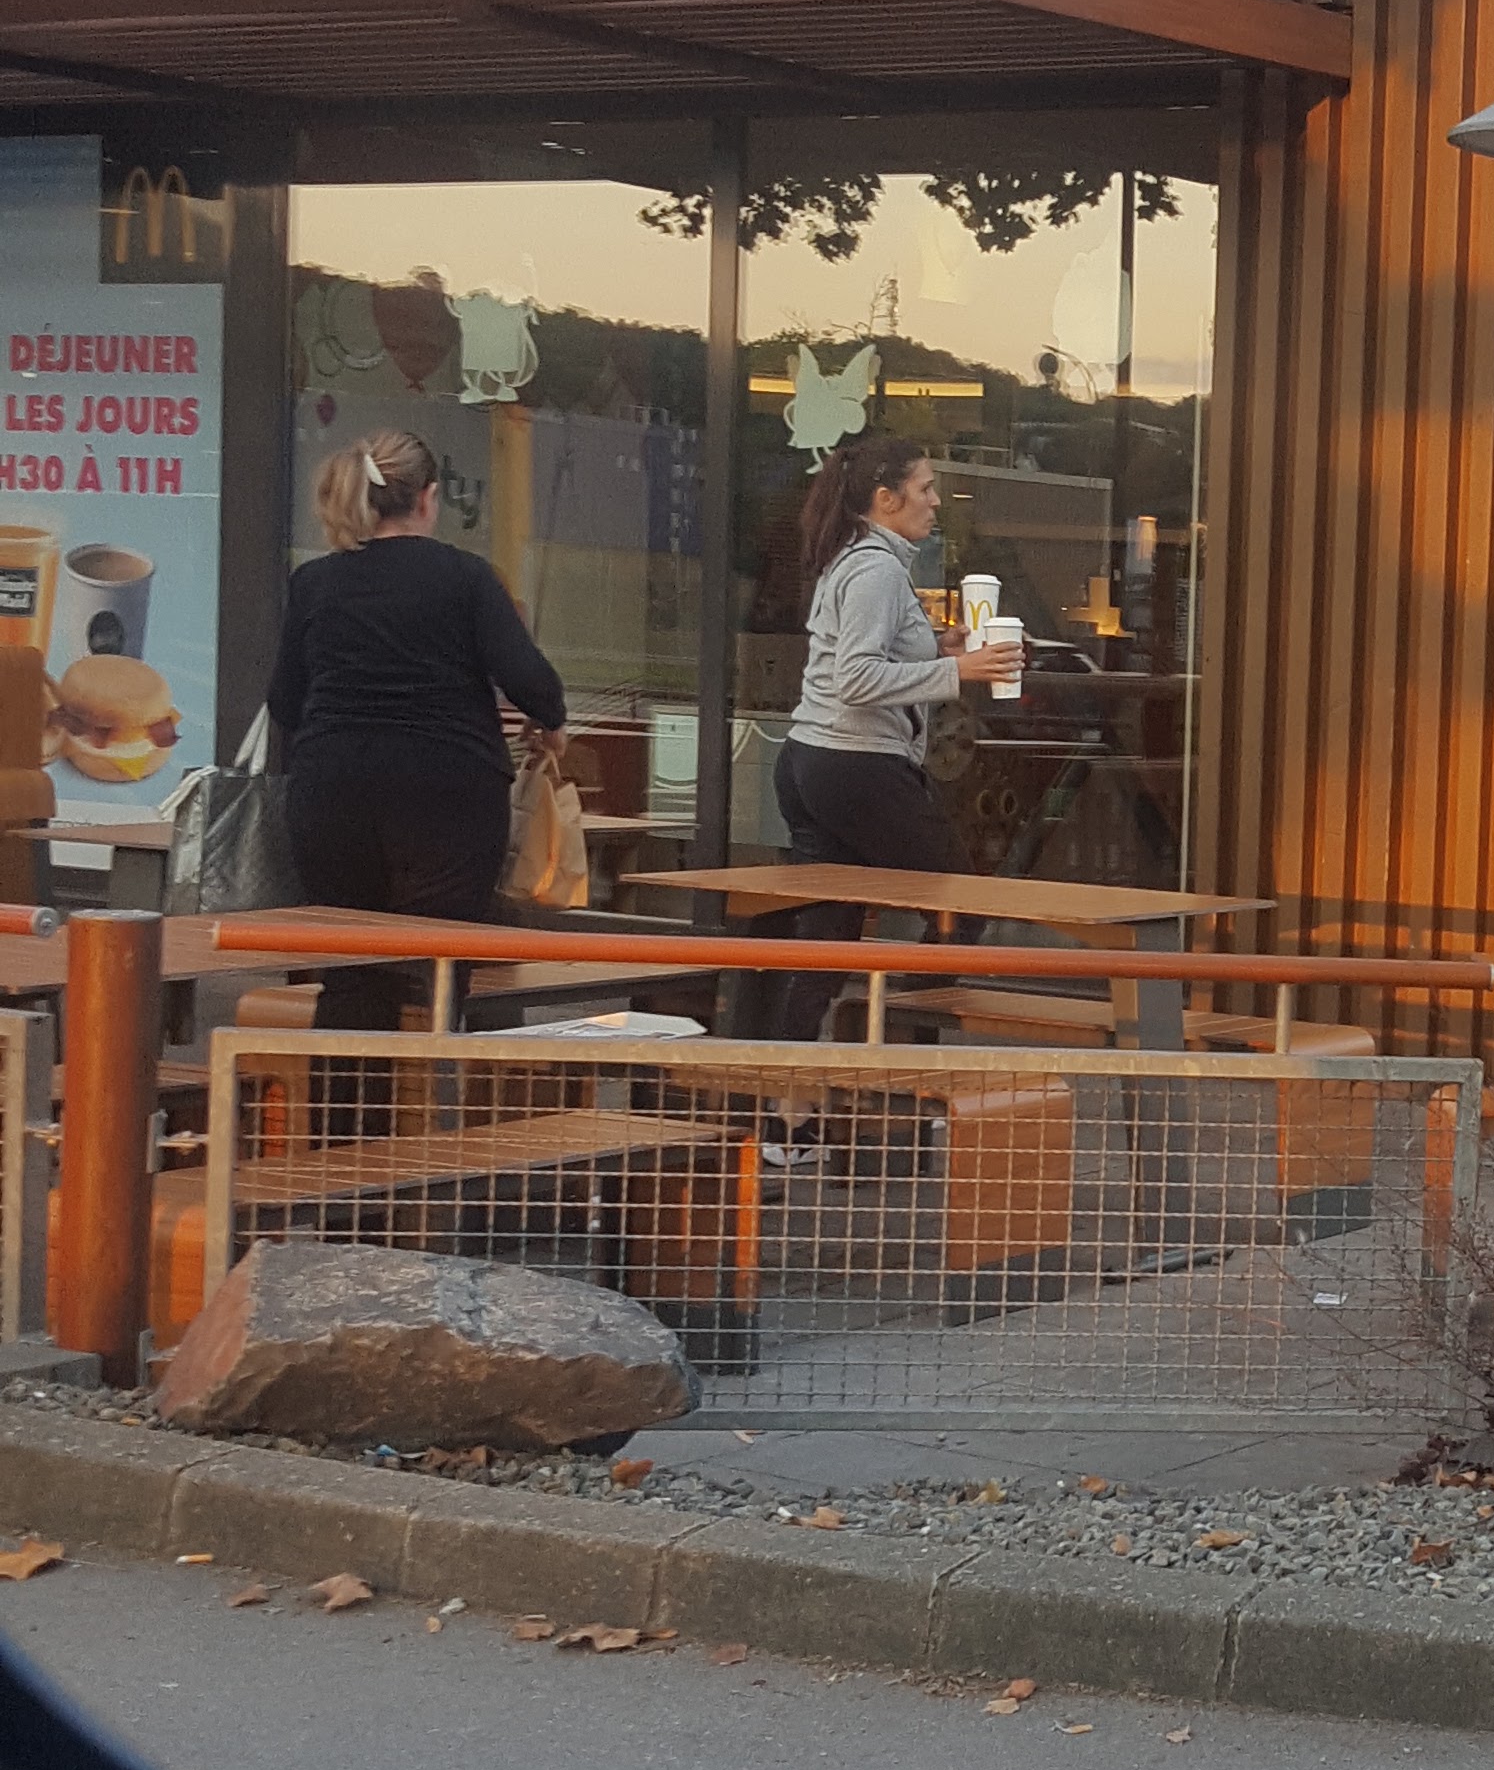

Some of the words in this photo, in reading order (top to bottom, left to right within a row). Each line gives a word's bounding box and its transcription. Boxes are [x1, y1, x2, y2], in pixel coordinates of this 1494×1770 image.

[6, 394, 65, 434] LES
[76, 395, 200, 436] JOURS
[0, 454, 64, 492] H30
[117, 455, 182, 495] 11H
